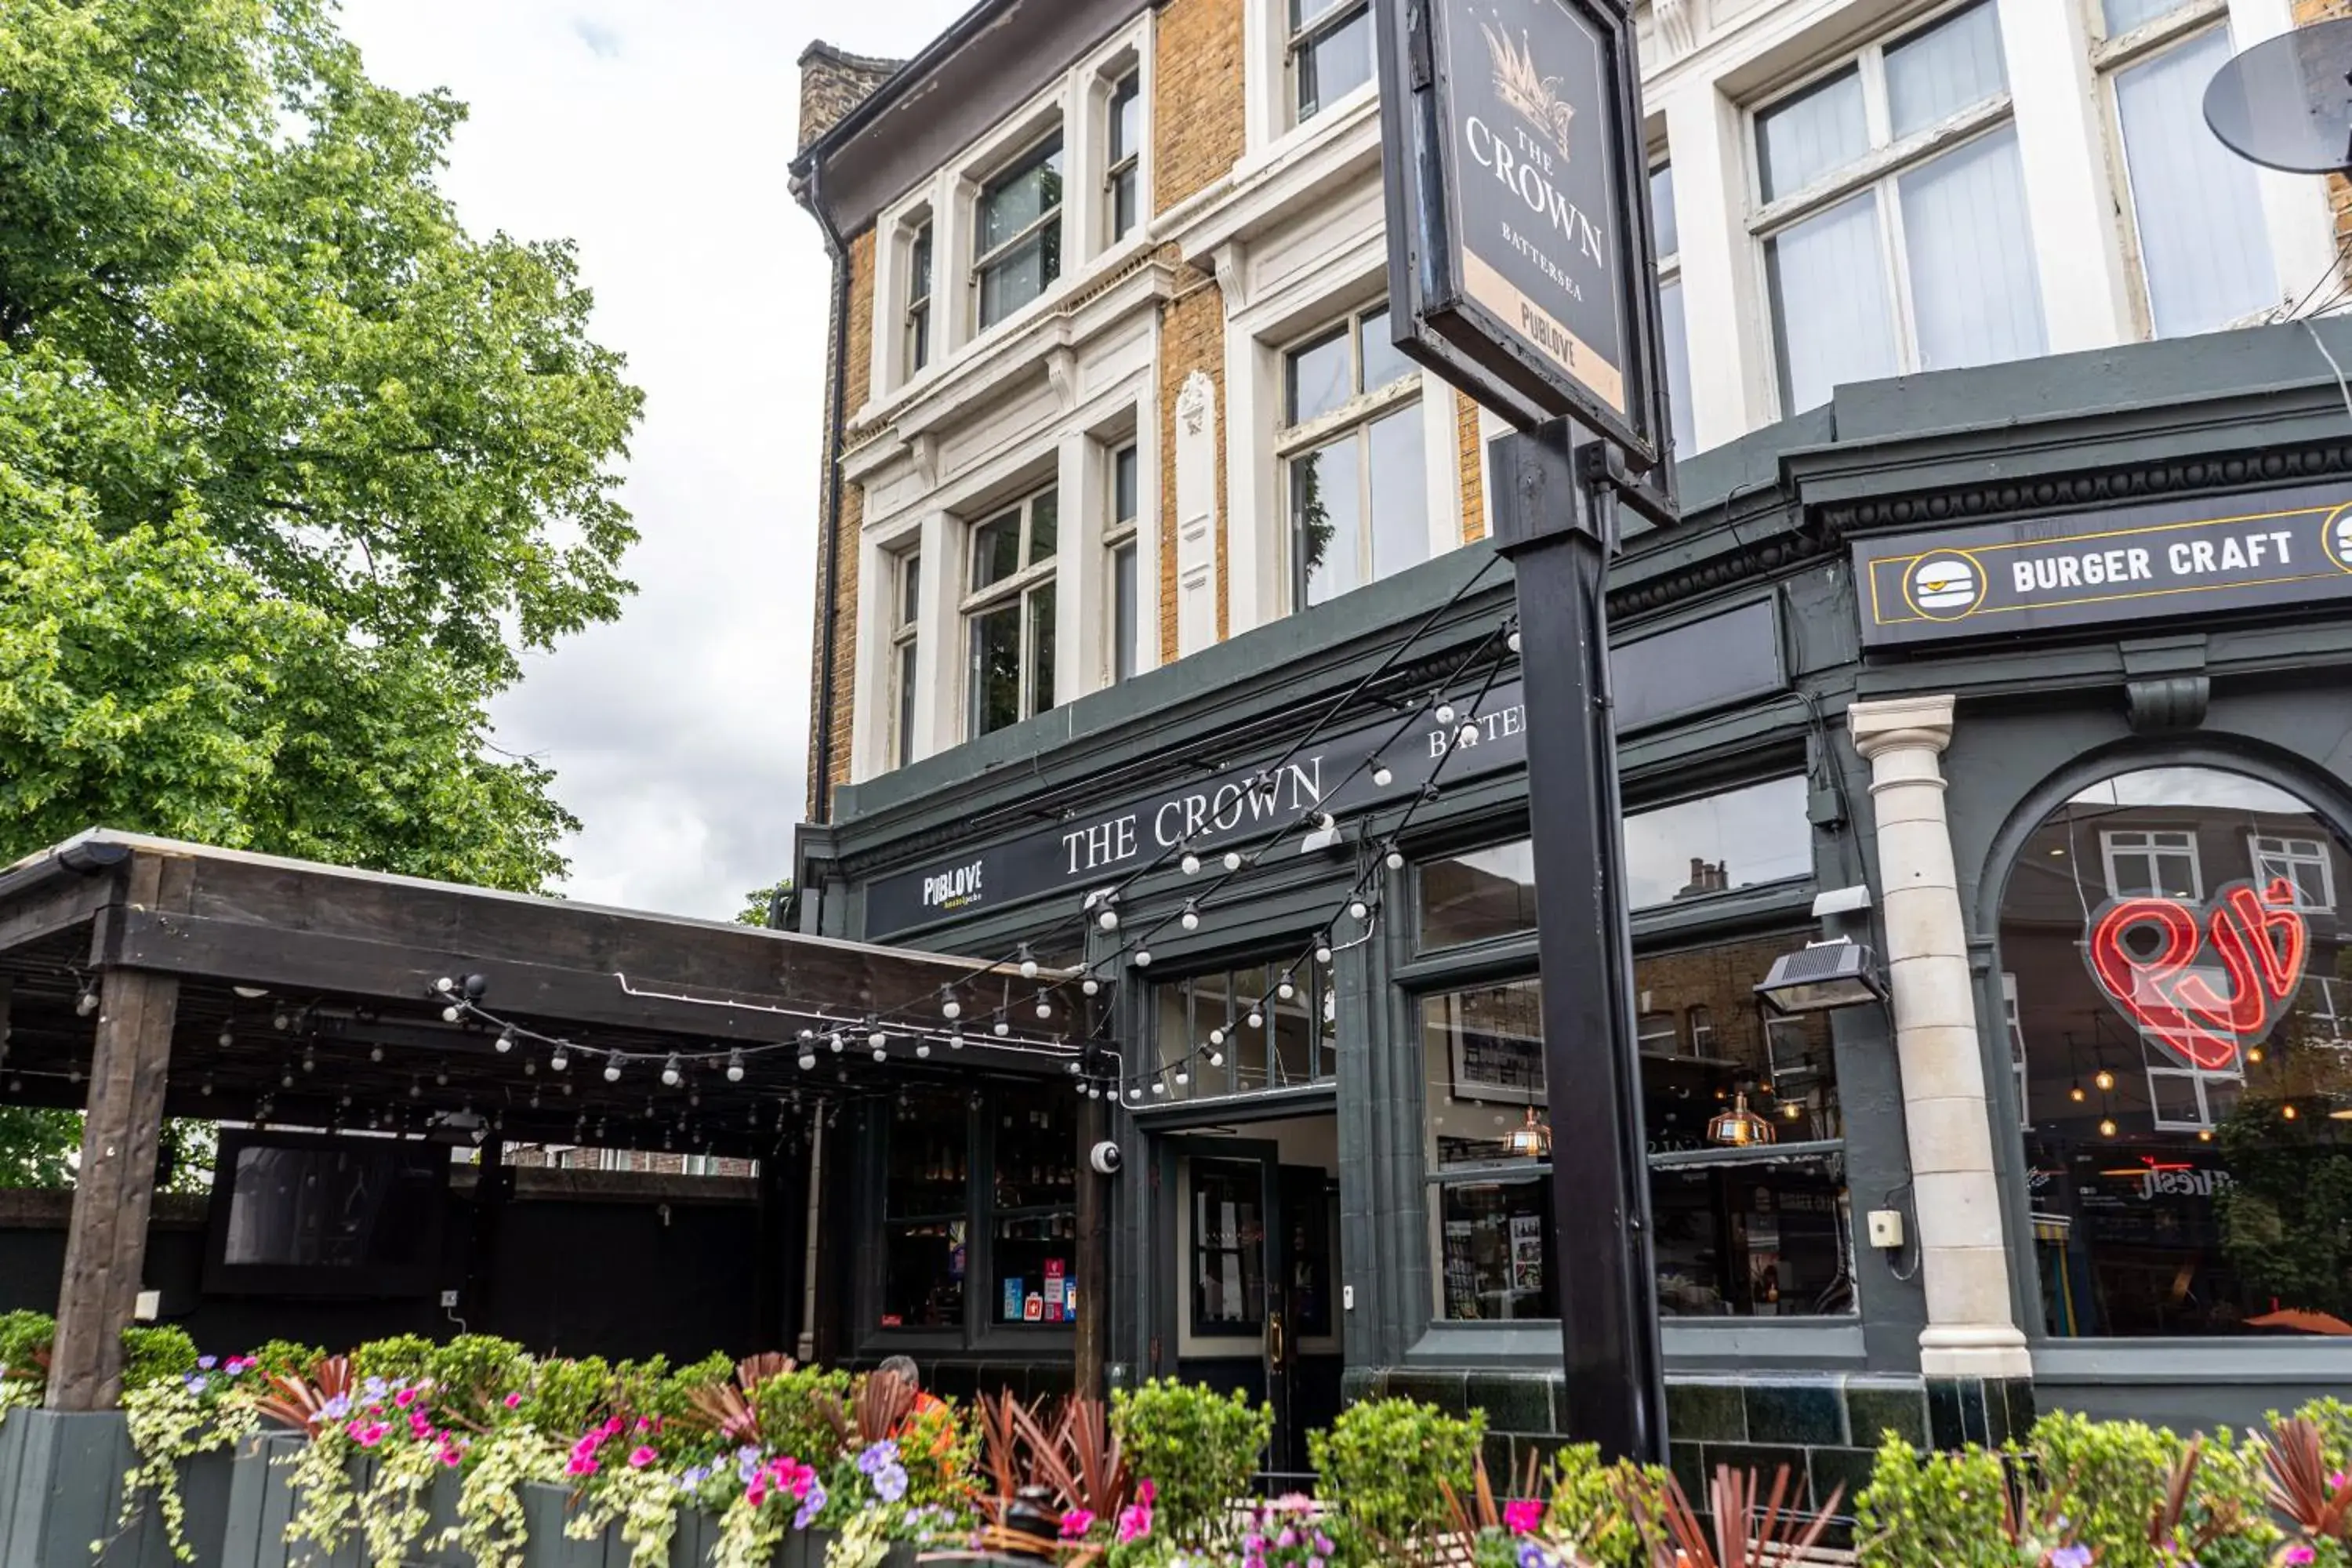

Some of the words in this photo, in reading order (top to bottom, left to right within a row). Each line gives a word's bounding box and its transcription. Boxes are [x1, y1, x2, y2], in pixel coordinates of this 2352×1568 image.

[1515, 126, 1554, 176] THE
[1466, 116, 1602, 270] CROWN
[1501, 221, 1583, 302] BATTERSEA
[1521, 302, 1575, 367] PUBLOVE
[2013, 548, 2152, 593] BURGER
[2168, 531, 2292, 575] CRAFT
[1062, 815, 1137, 874] THE
[1155, 756, 1323, 848] CROWN
[924, 860, 982, 906] PUBLOVE
